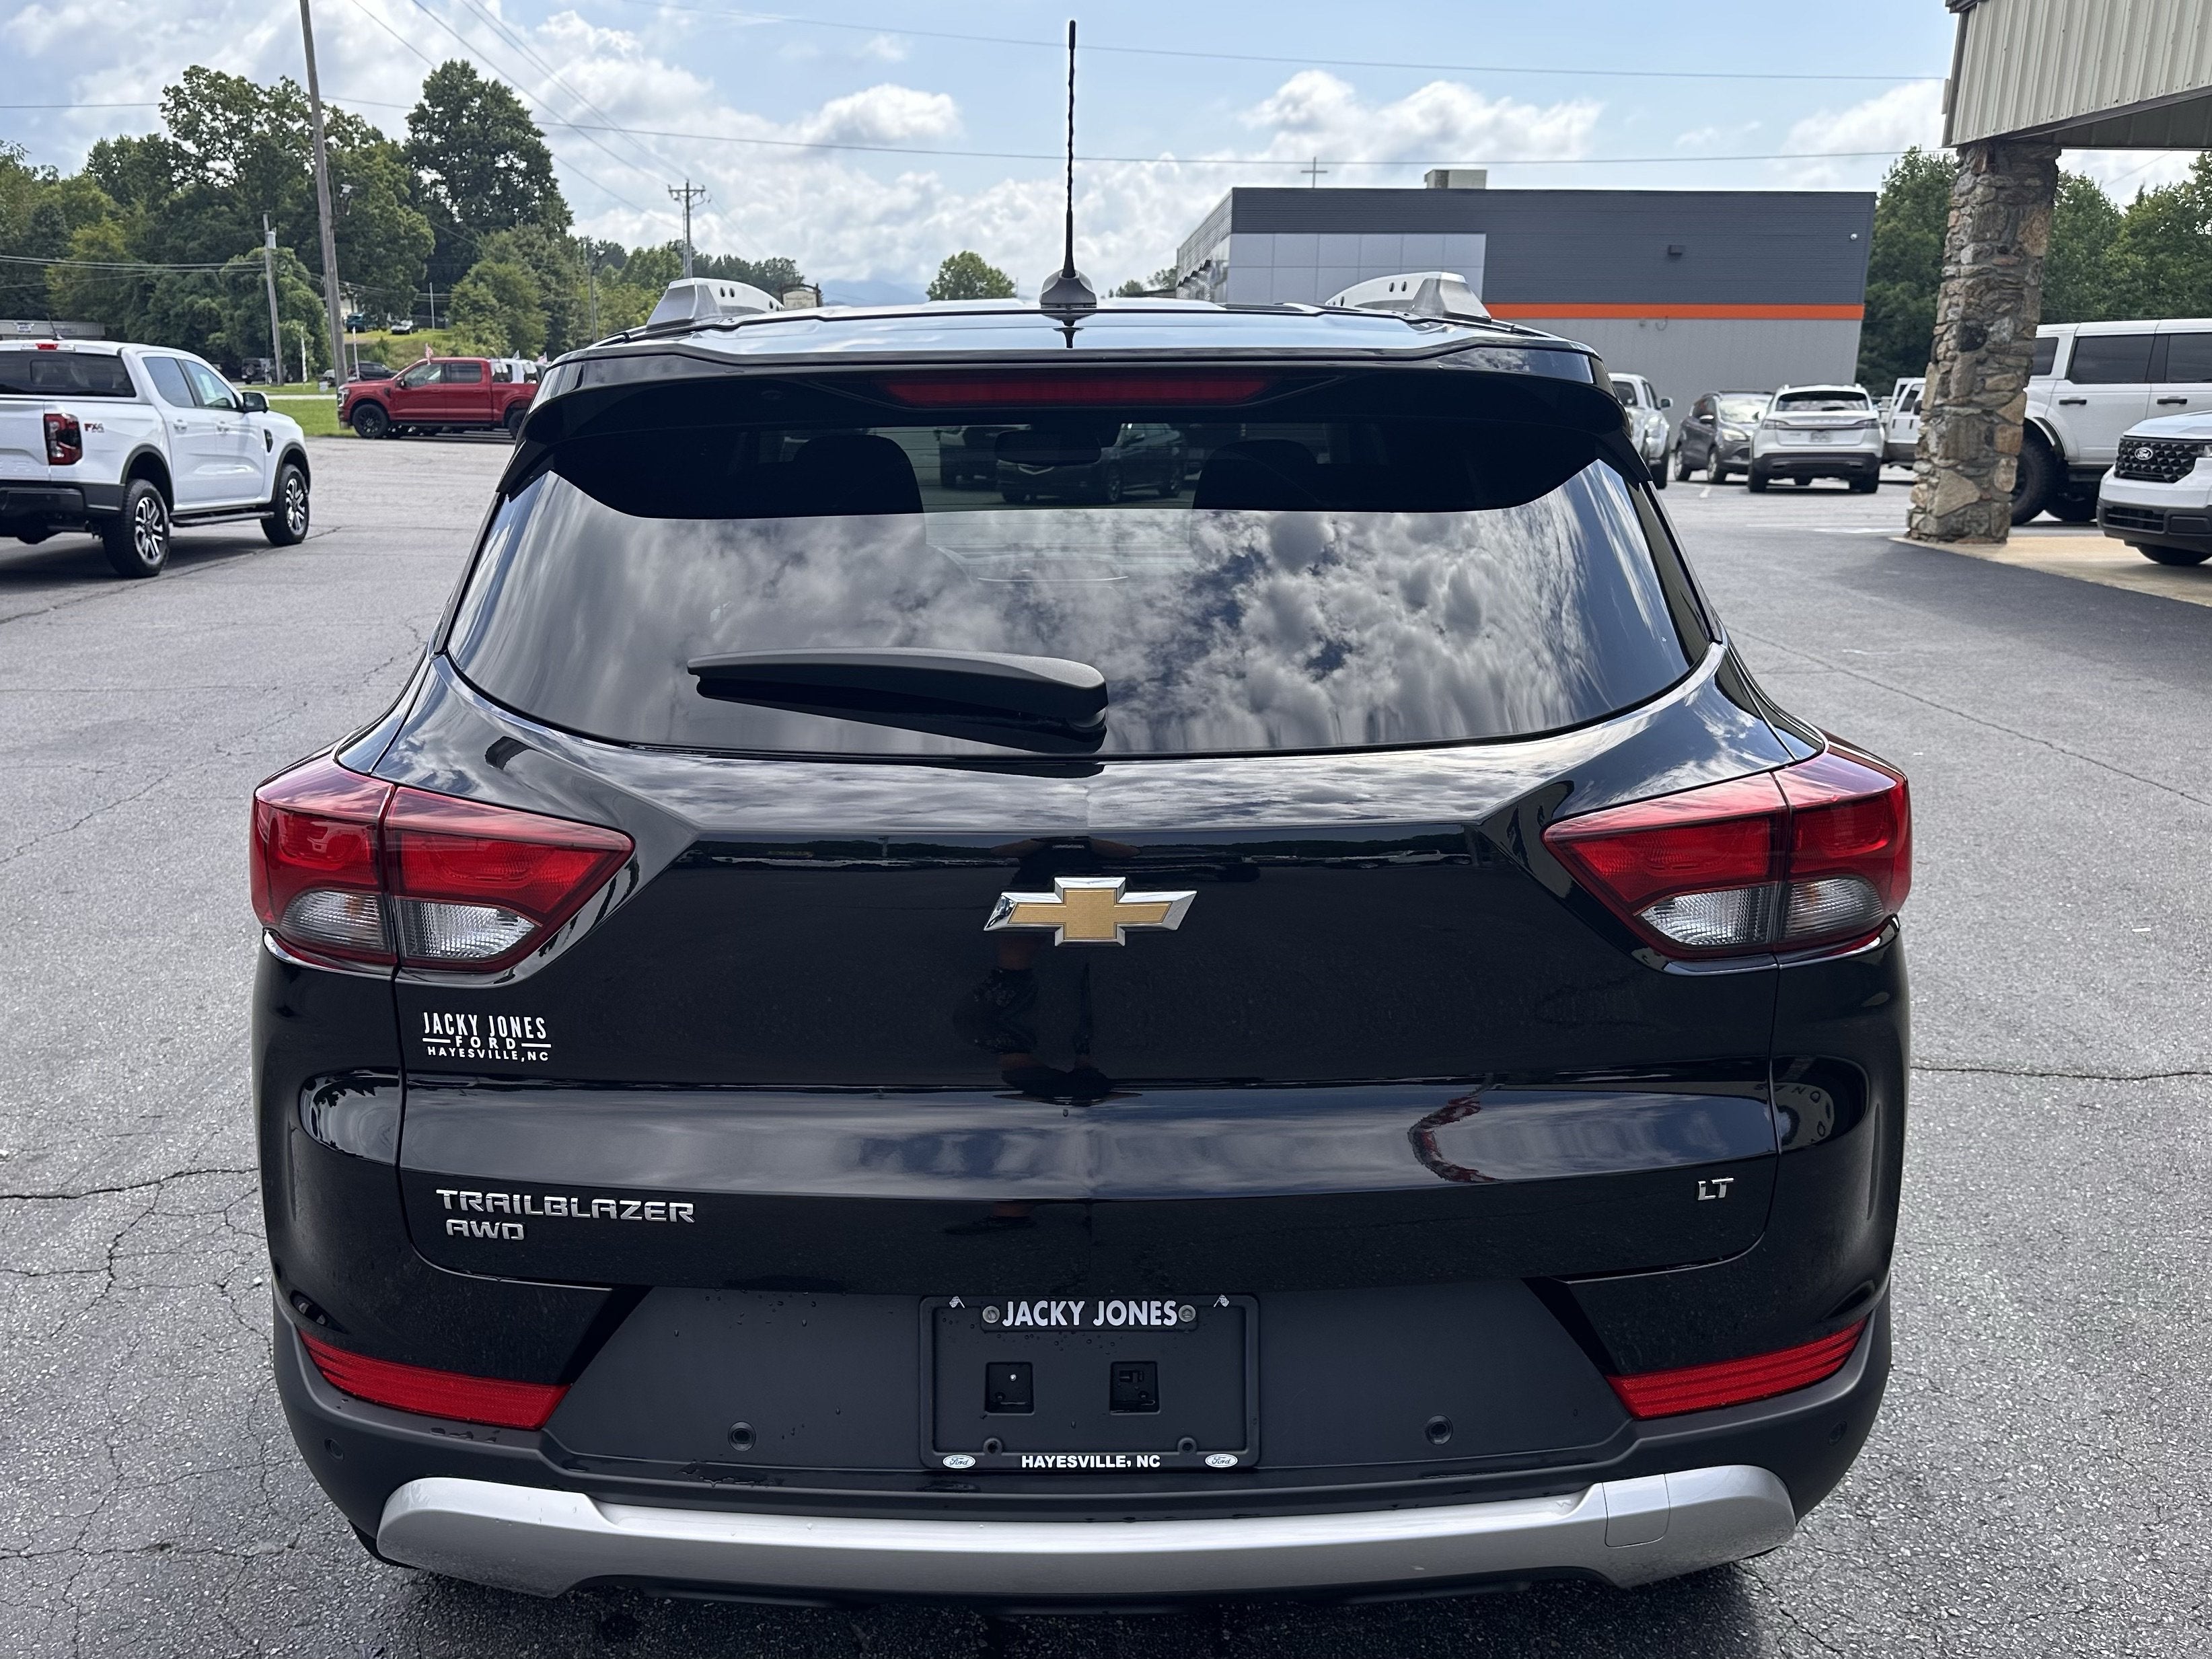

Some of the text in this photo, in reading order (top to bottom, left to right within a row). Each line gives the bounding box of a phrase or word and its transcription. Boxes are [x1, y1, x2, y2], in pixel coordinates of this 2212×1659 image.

[423, 1012, 546, 1039] JACKY JONES
[455, 1035, 516, 1049] FORD
[1697, 1177, 1734, 1201] LT
[436, 1189, 695, 1224] TRAILBLAZER
[445, 1218, 525, 1241] AWD
[1002, 1300, 1177, 1327] JACKY JONES
[1021, 1454, 1161, 1469] HAYESVILLE, NC
